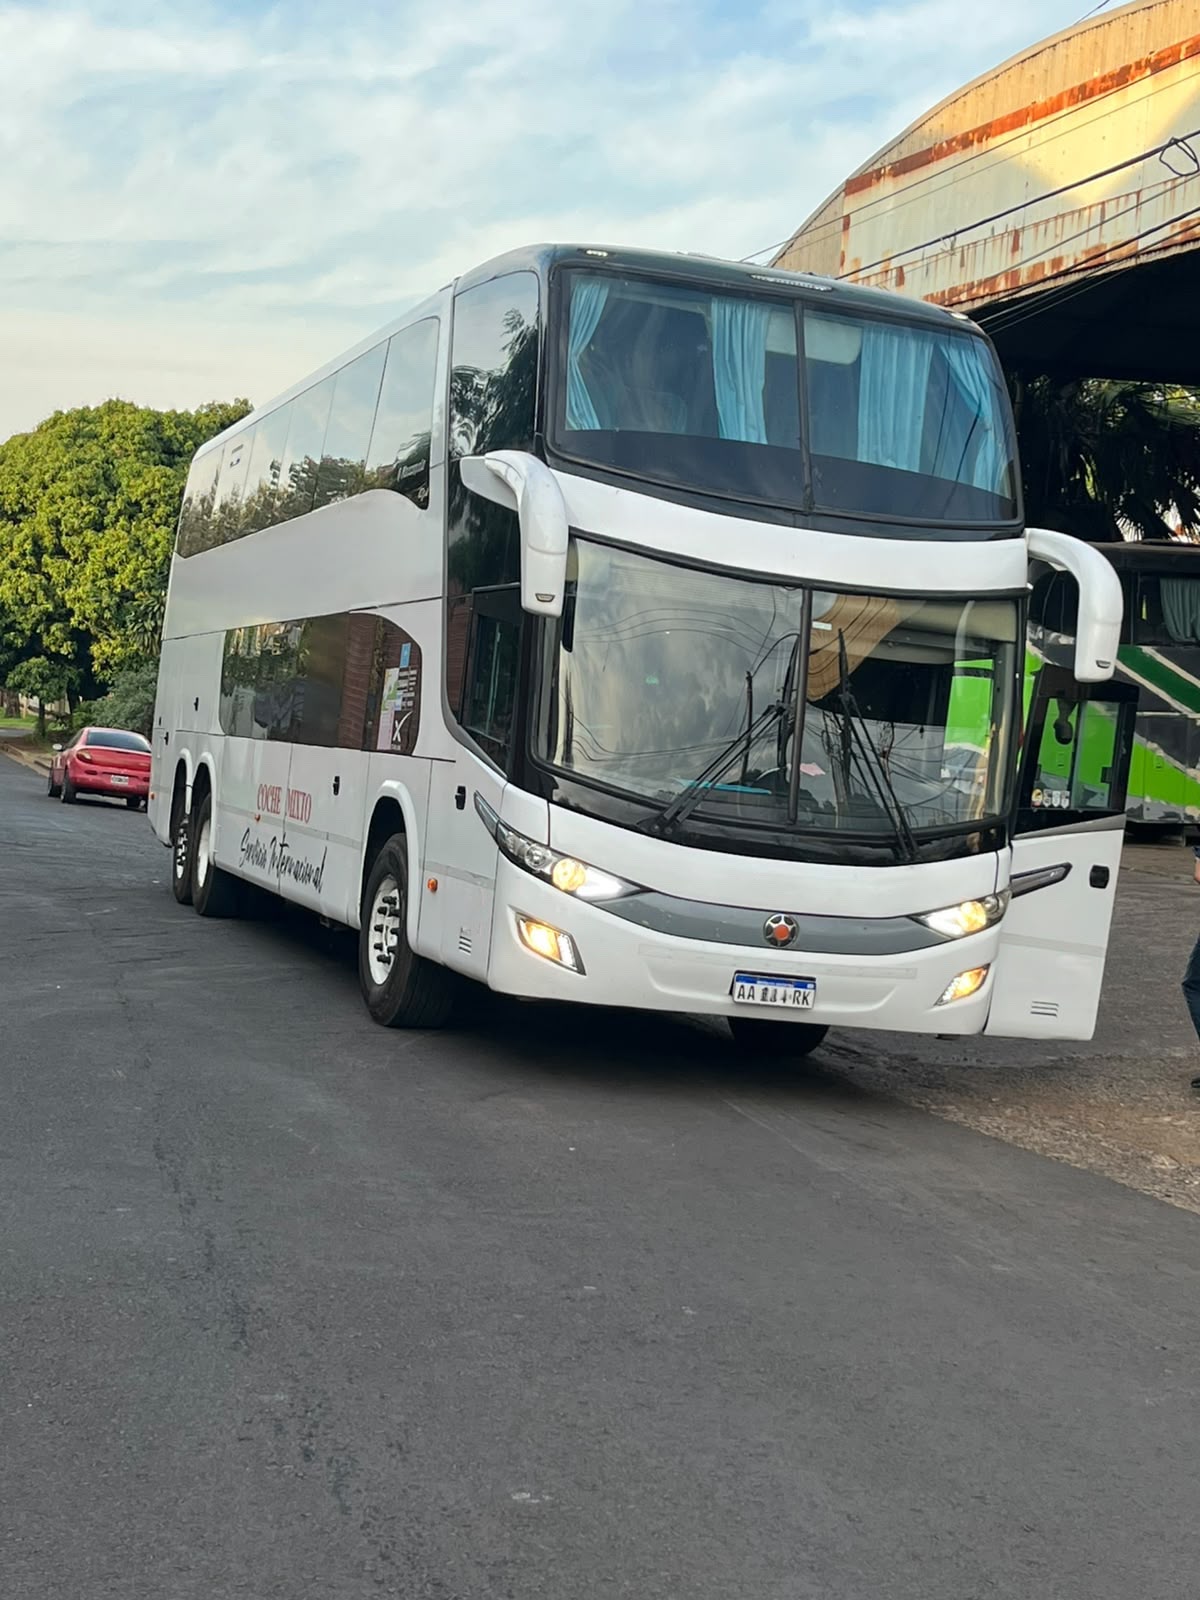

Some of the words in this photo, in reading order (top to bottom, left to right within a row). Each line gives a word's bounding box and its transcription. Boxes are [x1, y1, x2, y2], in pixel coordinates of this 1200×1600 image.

[257, 783, 282, 814] COCHE
[286, 788, 312, 824] MIXTO
[737, 984, 755, 1000] AA
